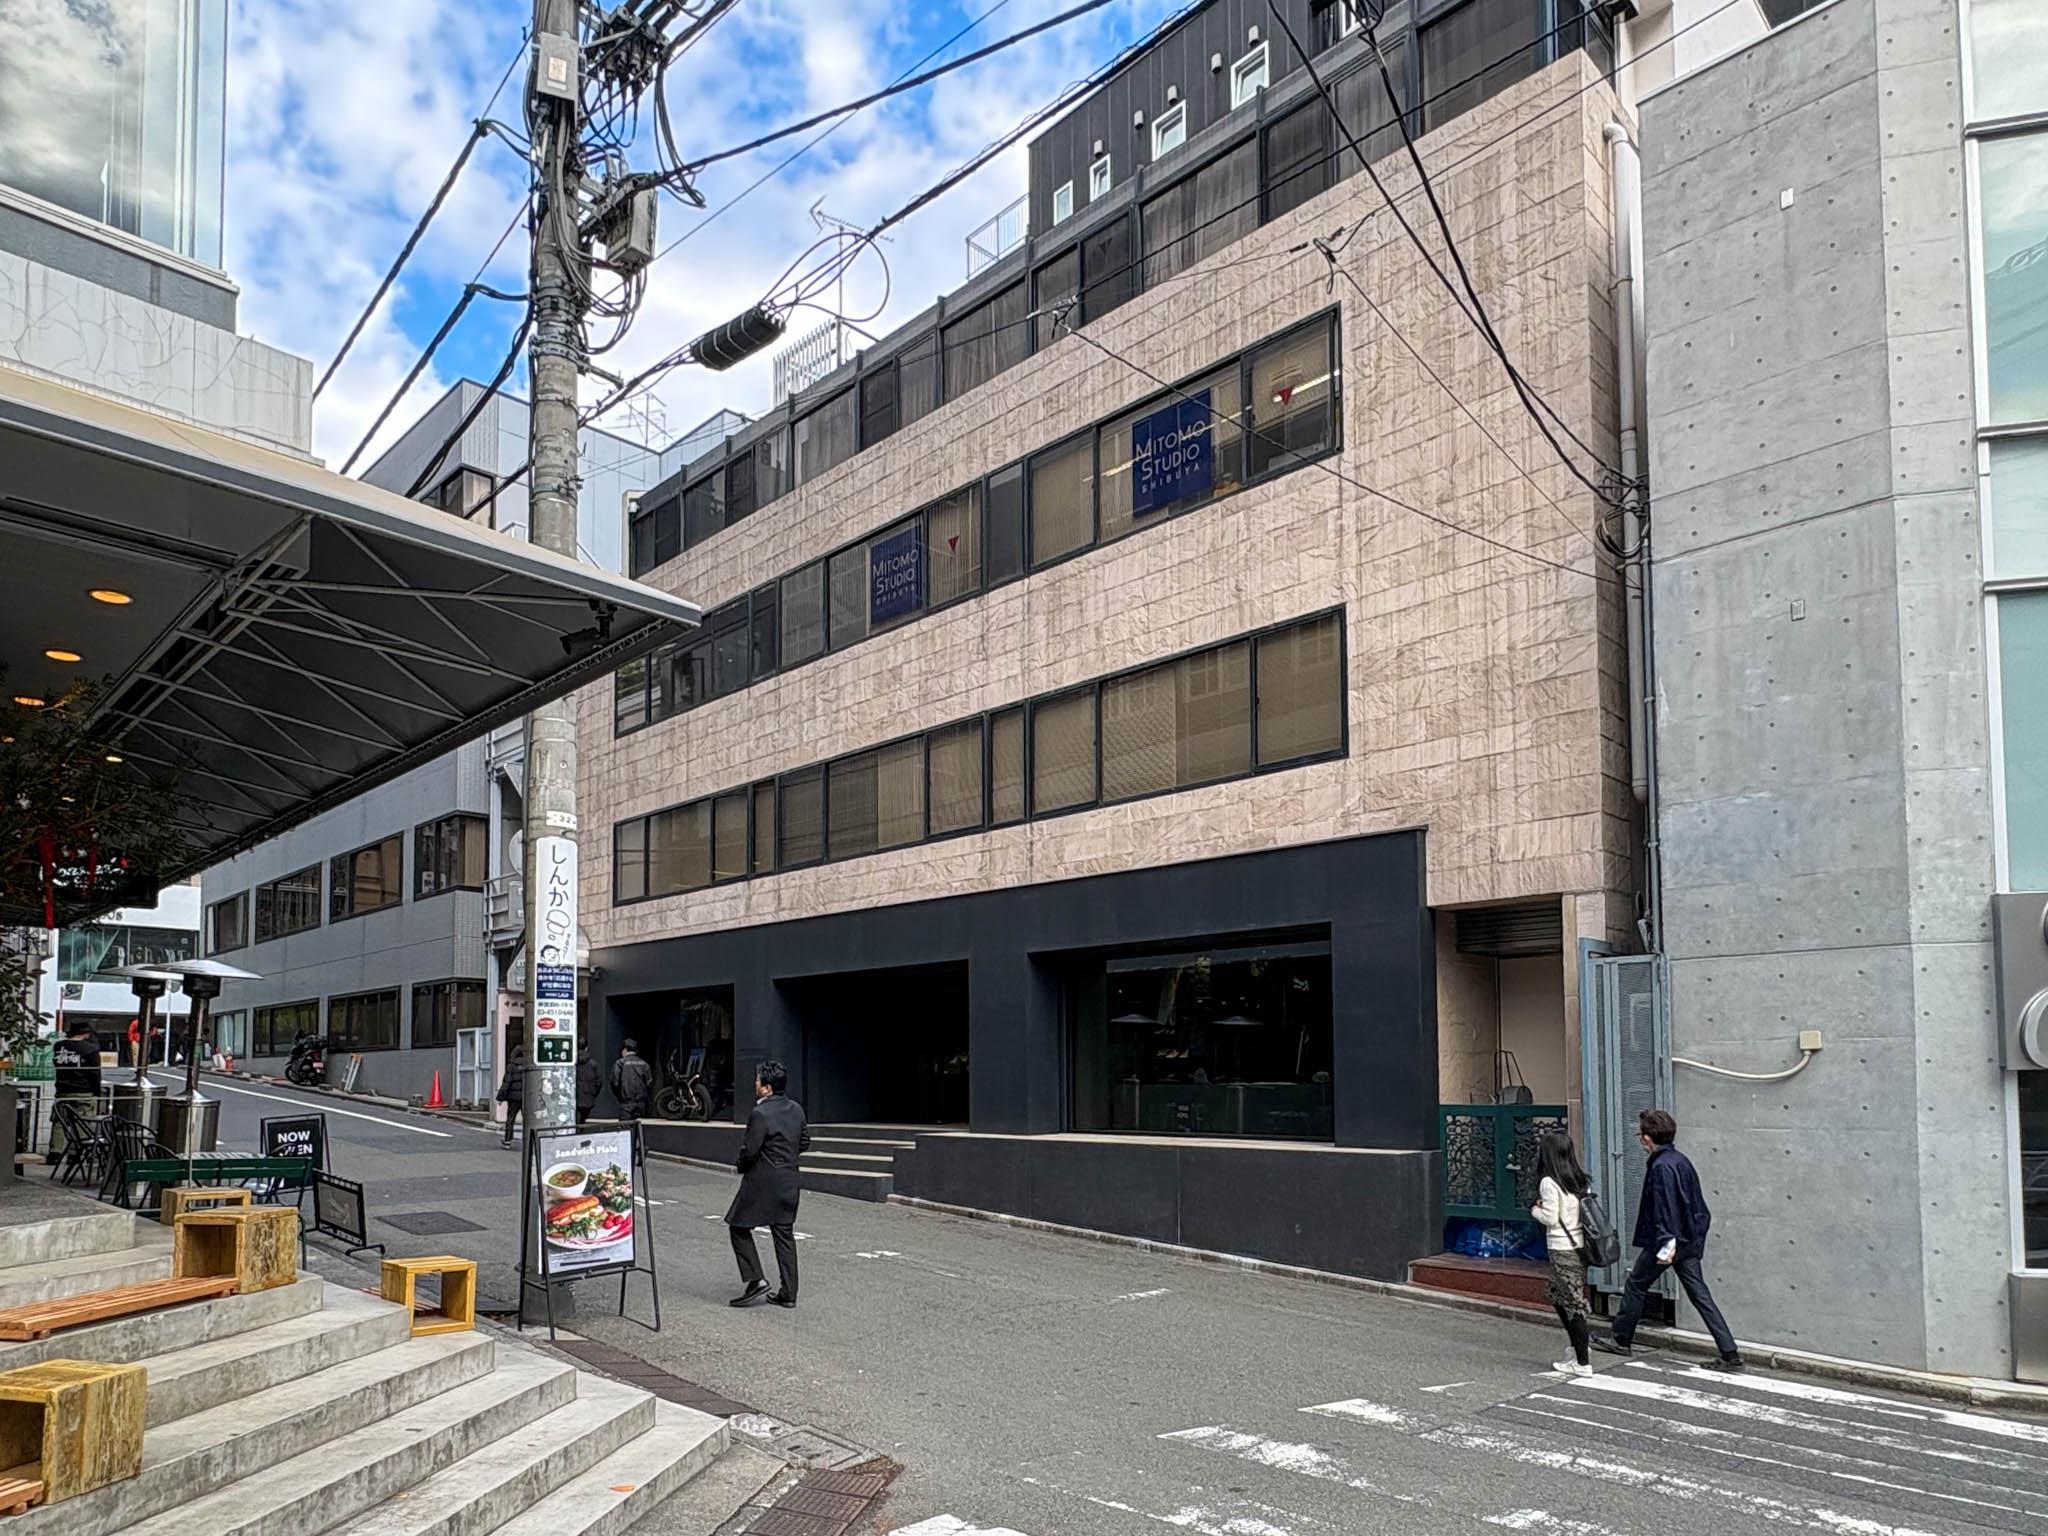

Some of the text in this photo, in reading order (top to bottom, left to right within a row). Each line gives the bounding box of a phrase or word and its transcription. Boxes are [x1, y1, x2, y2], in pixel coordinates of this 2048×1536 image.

[1141, 444, 1200, 481] STUDIO
[1141, 463, 1200, 494] SHIBUYA
[876, 568, 915, 595] STUDIO
[547, 1051, 567, 1061] 1-6
[277, 1130, 310, 1143] NOW
[279, 1143, 313, 1156] EN
[555, 1144, 618, 1158] Sandwich Plate
